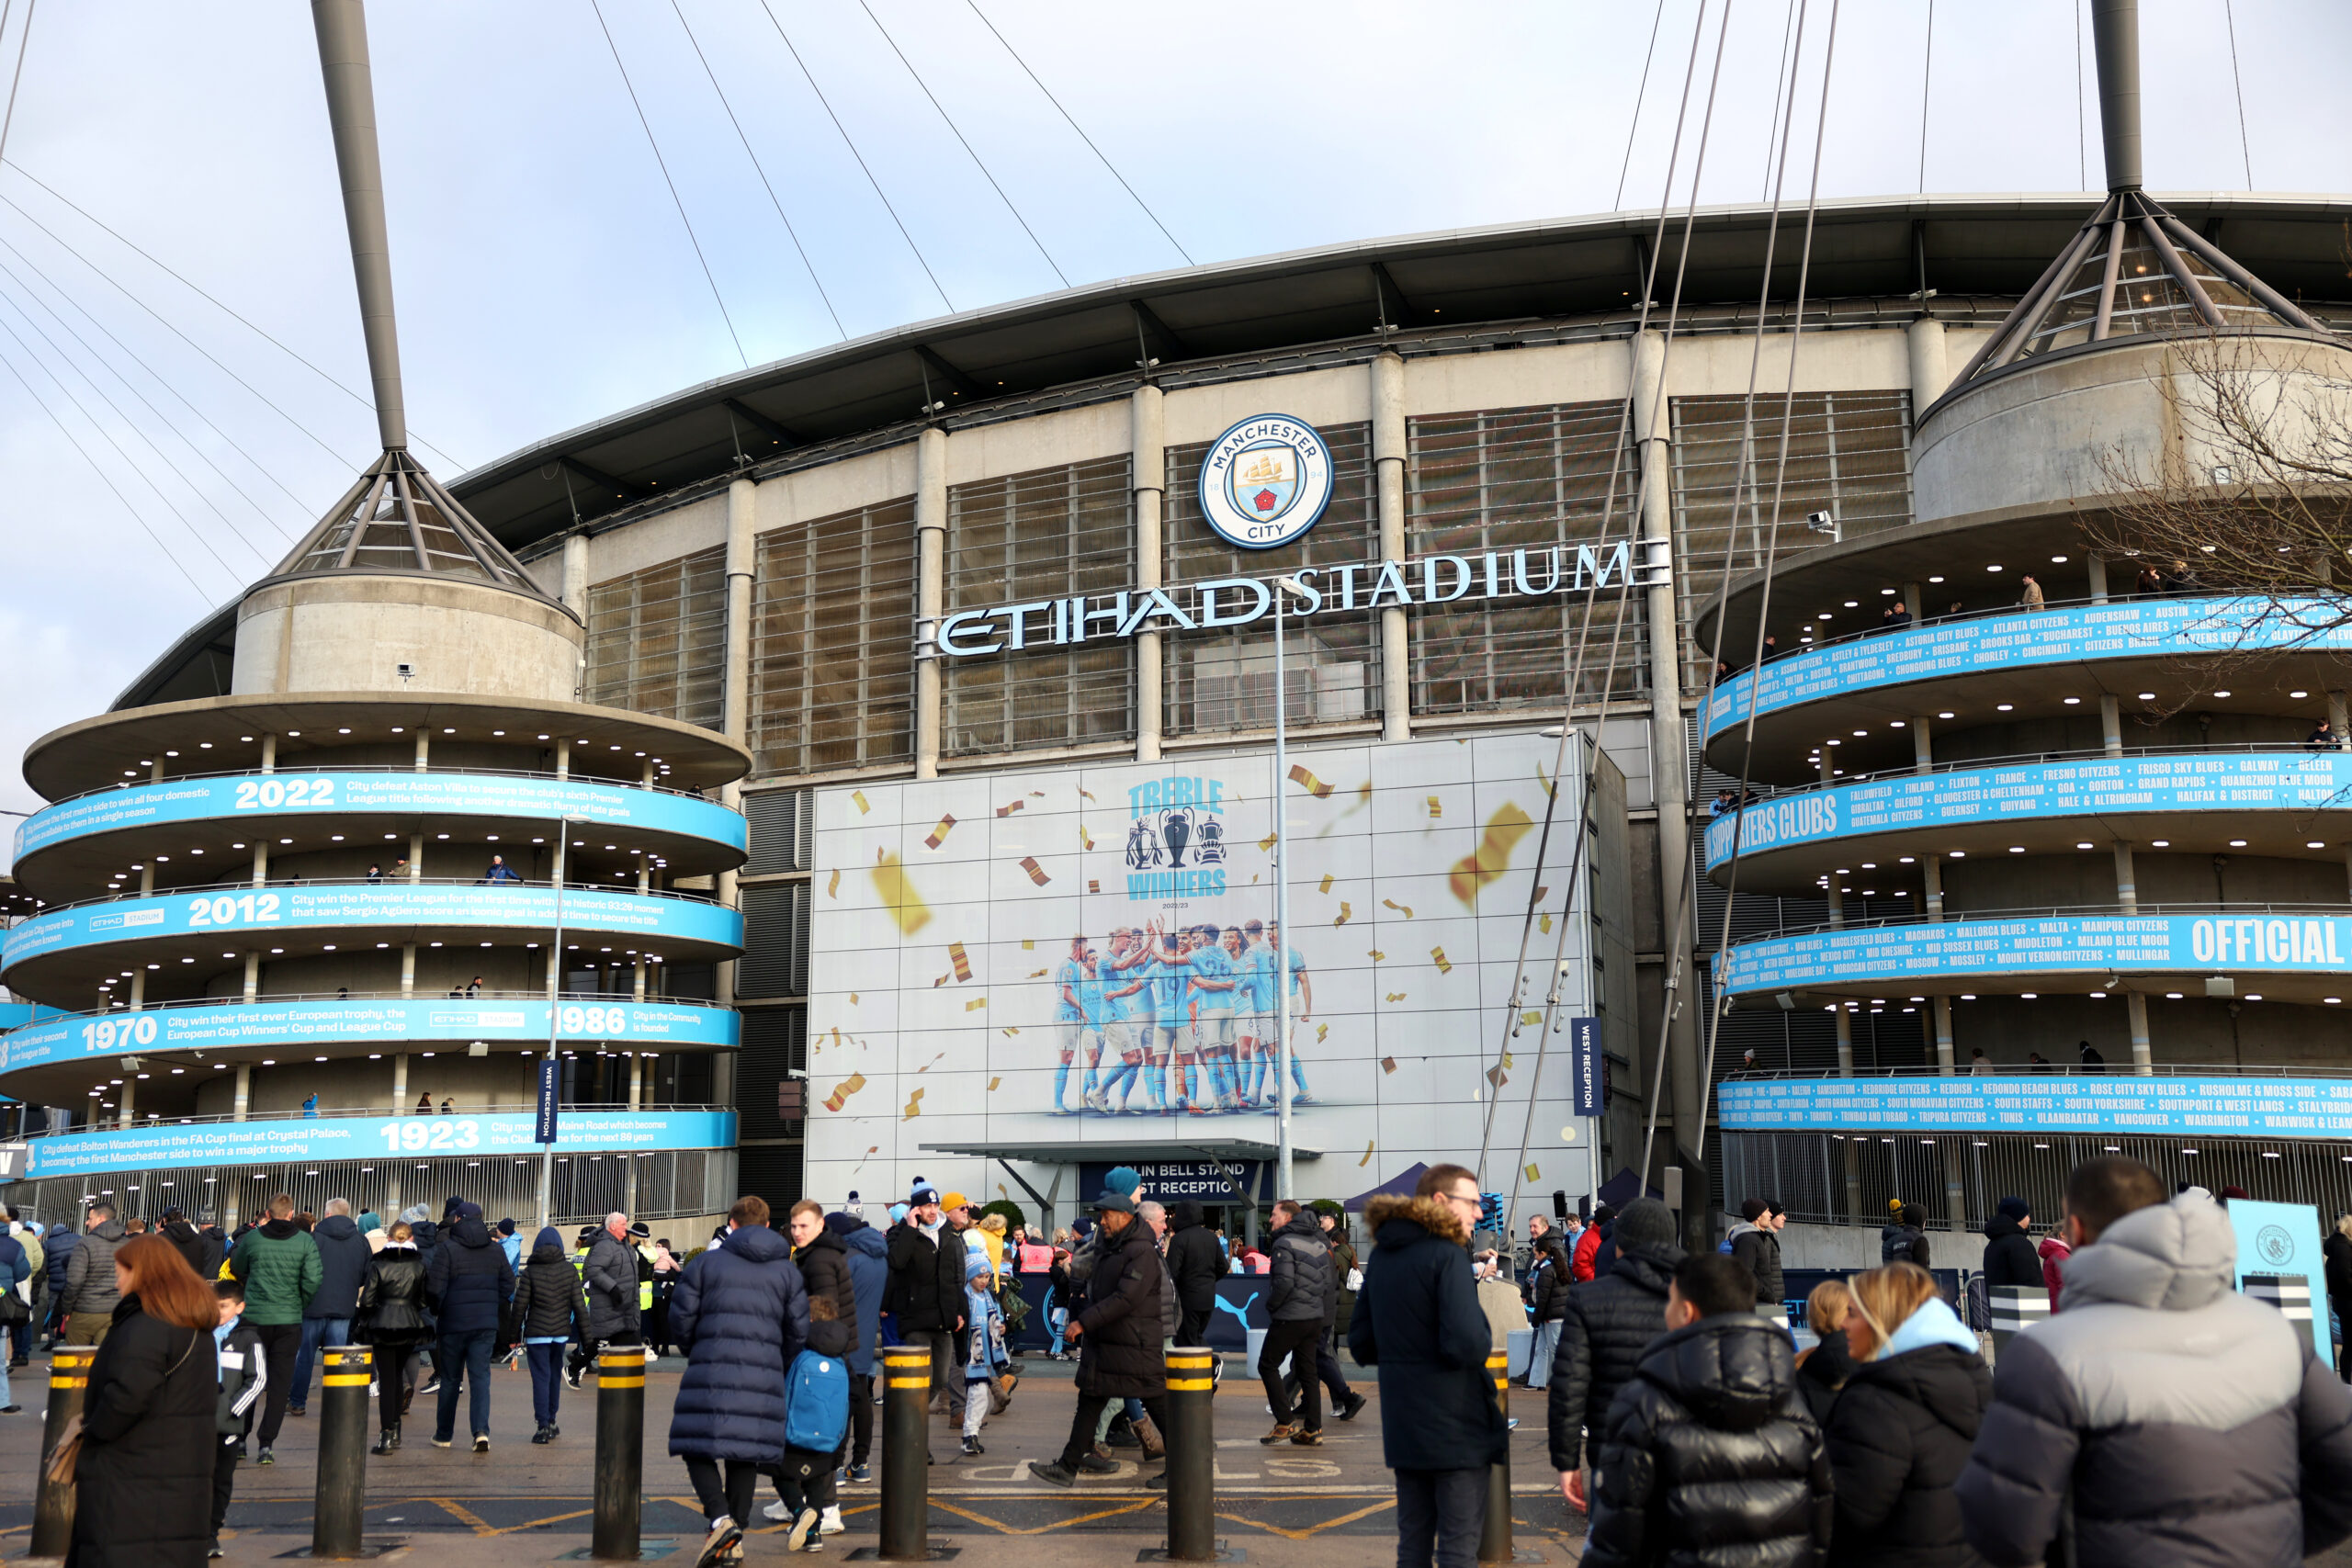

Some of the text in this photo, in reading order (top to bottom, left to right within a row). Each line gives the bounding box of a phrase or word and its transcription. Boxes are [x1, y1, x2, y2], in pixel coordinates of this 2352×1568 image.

[1214, 423, 1317, 469] MANCHESTER
[1209, 470, 1323, 491] 18 94
[1248, 524, 1285, 539] CITY
[938, 540, 1636, 656] ETIHAD STADIUM
[1905, 606, 2188, 648] ASTORIA CITY BLUES ATLANTA CITYZENS AUDENSHAW AUSTIN
[1932, 626, 2093, 657] BRISBANE BROOKS BAR BUCHAREST
[1973, 642, 2071, 664] CHORLEY CINCINNATI
[1949, 760, 2333, 789] FLIXTON FRANCE FRESNO CITYZENS FRISCO SKY BLUES GALWAY GELEEN
[119, 786, 210, 807] win all four domestic
[235, 779, 334, 808] 2022
[346, 782, 369, 793] City
[371, 782, 407, 791] defeat
[410, 782, 441, 792] Aston
[444, 783, 467, 793] Villa
[469, 784, 481, 794] to
[519, 786, 536, 796] the
[566, 790, 589, 800] sixth
[591, 792, 625, 804] Premier
[346, 794, 504, 806] League title following another
[1128, 776, 1224, 820] TREBLE
[1934, 790, 1981, 804] GLOUCESTER
[1990, 784, 2045, 799] CHELTENHAM
[2057, 782, 2075, 794] GOA
[2088, 780, 2124, 792] GORTON
[2138, 777, 2169, 789] GRAND
[2171, 776, 2206, 788] RAPIDS
[2221, 775, 2277, 786] GUANGZHOU
[2278, 775, 2302, 786] BLUE
[2304, 775, 2334, 786] MOON
[1779, 795, 1838, 840] CLUBS
[1127, 868, 1226, 900] WINNERS
[189, 894, 280, 927] 2012
[291, 894, 447, 906] City win the Premier League
[2040, 920, 2169, 933] MALTA MANIPUR CITYZENS
[2077, 935, 2170, 947] MILANO BLUE MOON
[2192, 919, 2345, 964] OFFICIAL
[167, 1009, 406, 1028] City win their first ever European trophy, the
[546, 1007, 626, 1034] 1986
[633, 1011, 649, 1022] City
[656, 1011, 668, 1021] the
[668, 1011, 702, 1025] Community
[640, 1024, 669, 1032] founded
[82, 1016, 158, 1051] 1970
[167, 1028, 216, 1040] European
[218, 1026, 240, 1038] Cup
[291, 1023, 314, 1034] Cup
[315, 1022, 337, 1032] and
[340, 1021, 381, 1033] League
[383, 1021, 406, 1032] Cup
[1581, 1025, 1592, 1108] WEST RECEPTION
[2090, 1084, 2316, 1099] ROSE CITY SKY BLUES RUSHOLME & MOSS SIDE
[543, 1091, 551, 1136] RECEPTION
[2158, 1100, 2285, 1112] SOUTHPORT & WEST LANCS
[586, 1121, 609, 1131] Road
[610, 1121, 634, 1130] which
[1999, 1112, 2315, 1129] TUNIS ULAANBAATAR VANCOUVER WARRINGTON WARWICK
[81, 1128, 352, 1152] Bolton Wanderers in the FA Cup final at Crystal Palace,
[380, 1120, 480, 1151] 1923
[41, 1156, 75, 1168] becoming
[76, 1155, 90, 1165] the
[91, 1154, 109, 1164] first
[110, 1150, 167, 1162] Manchester
[169, 1148, 191, 1158] side
[192, 1147, 203, 1156] to
[205, 1146, 225, 1156] win
[236, 1145, 267, 1157] major
[270, 1145, 309, 1156] trophy
[1159, 1165, 1194, 1176] BELL
[1198, 1164, 1244, 1176] STAND
[1160, 1180, 1242, 1194] RECEPTIO
